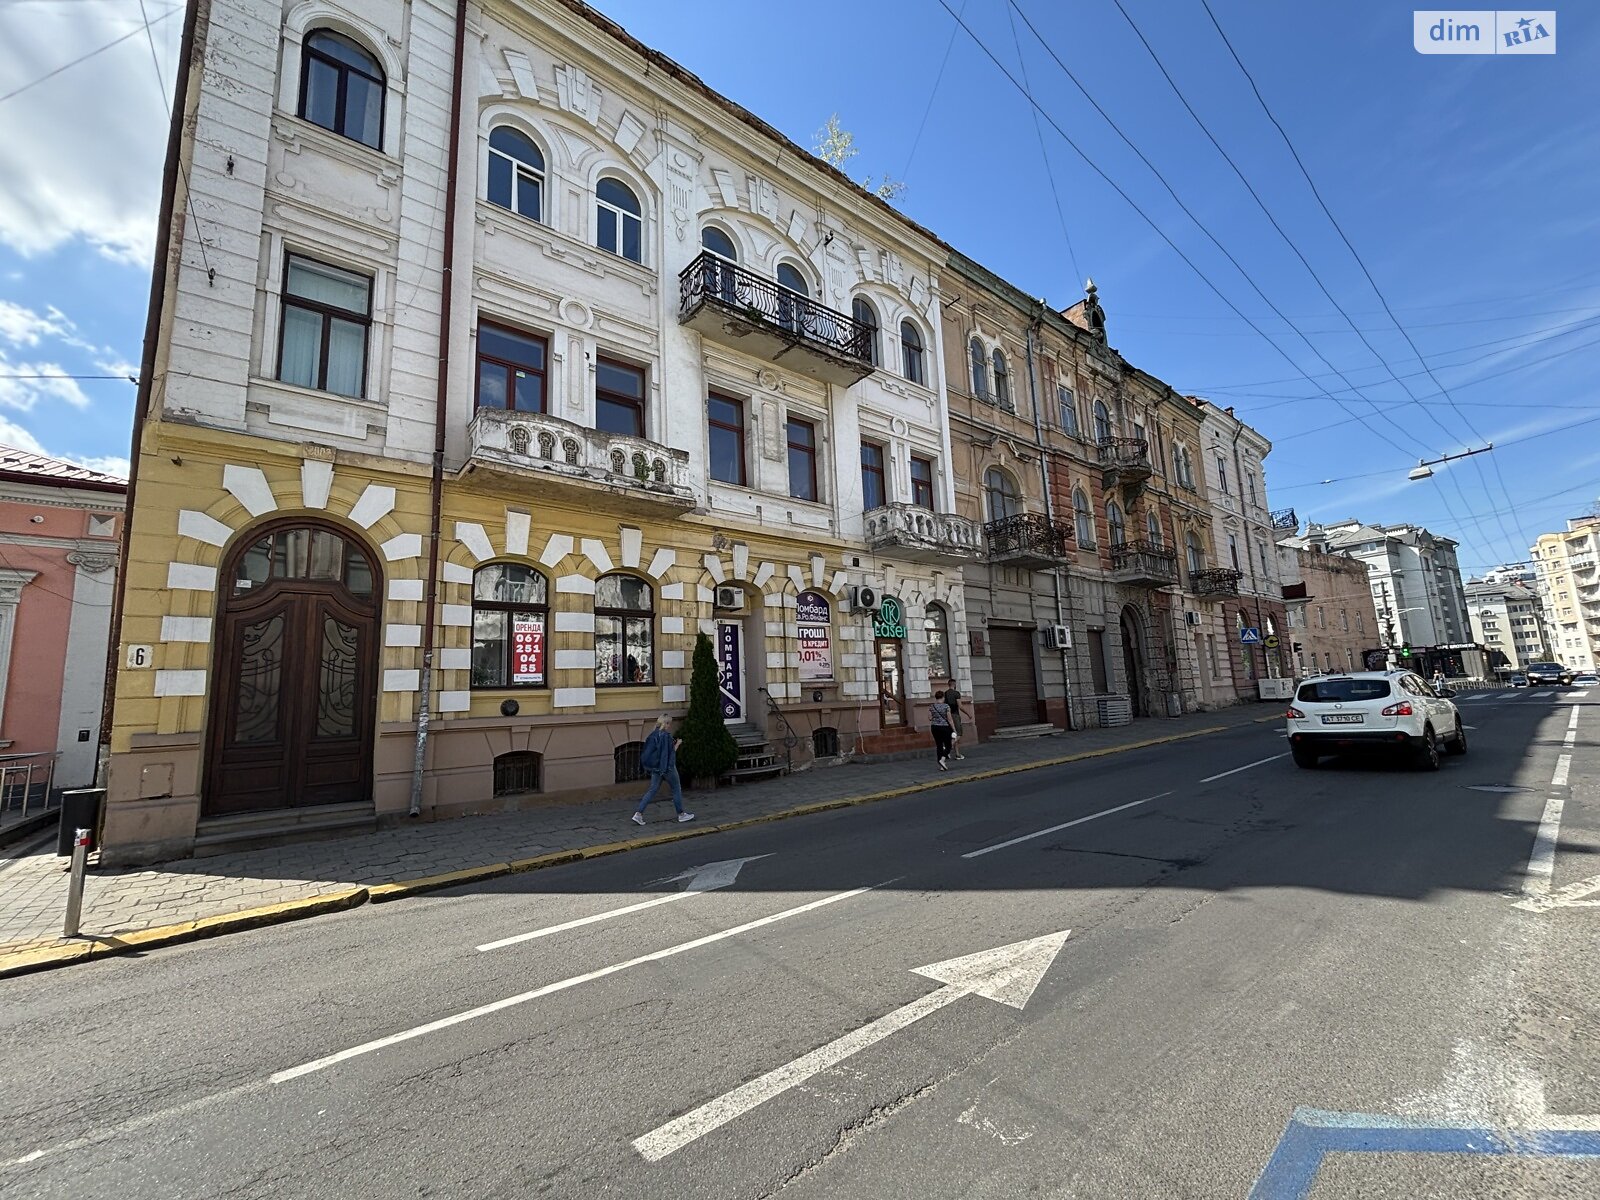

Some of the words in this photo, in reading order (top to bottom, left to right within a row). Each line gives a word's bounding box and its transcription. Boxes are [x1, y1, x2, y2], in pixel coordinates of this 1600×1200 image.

[516, 623, 541, 632] ОРЕНДА
[799, 628, 825, 638] ГРОШІ
[516, 634, 540, 643] 067
[516, 644, 540, 653] 251
[808, 640, 828, 648] КРЕДИТ
[136, 648, 145, 665] 6
[520, 654, 537, 663] 04
[724, 625, 733, 690] ЛОМБАРД
[520, 664, 536, 673] 55
